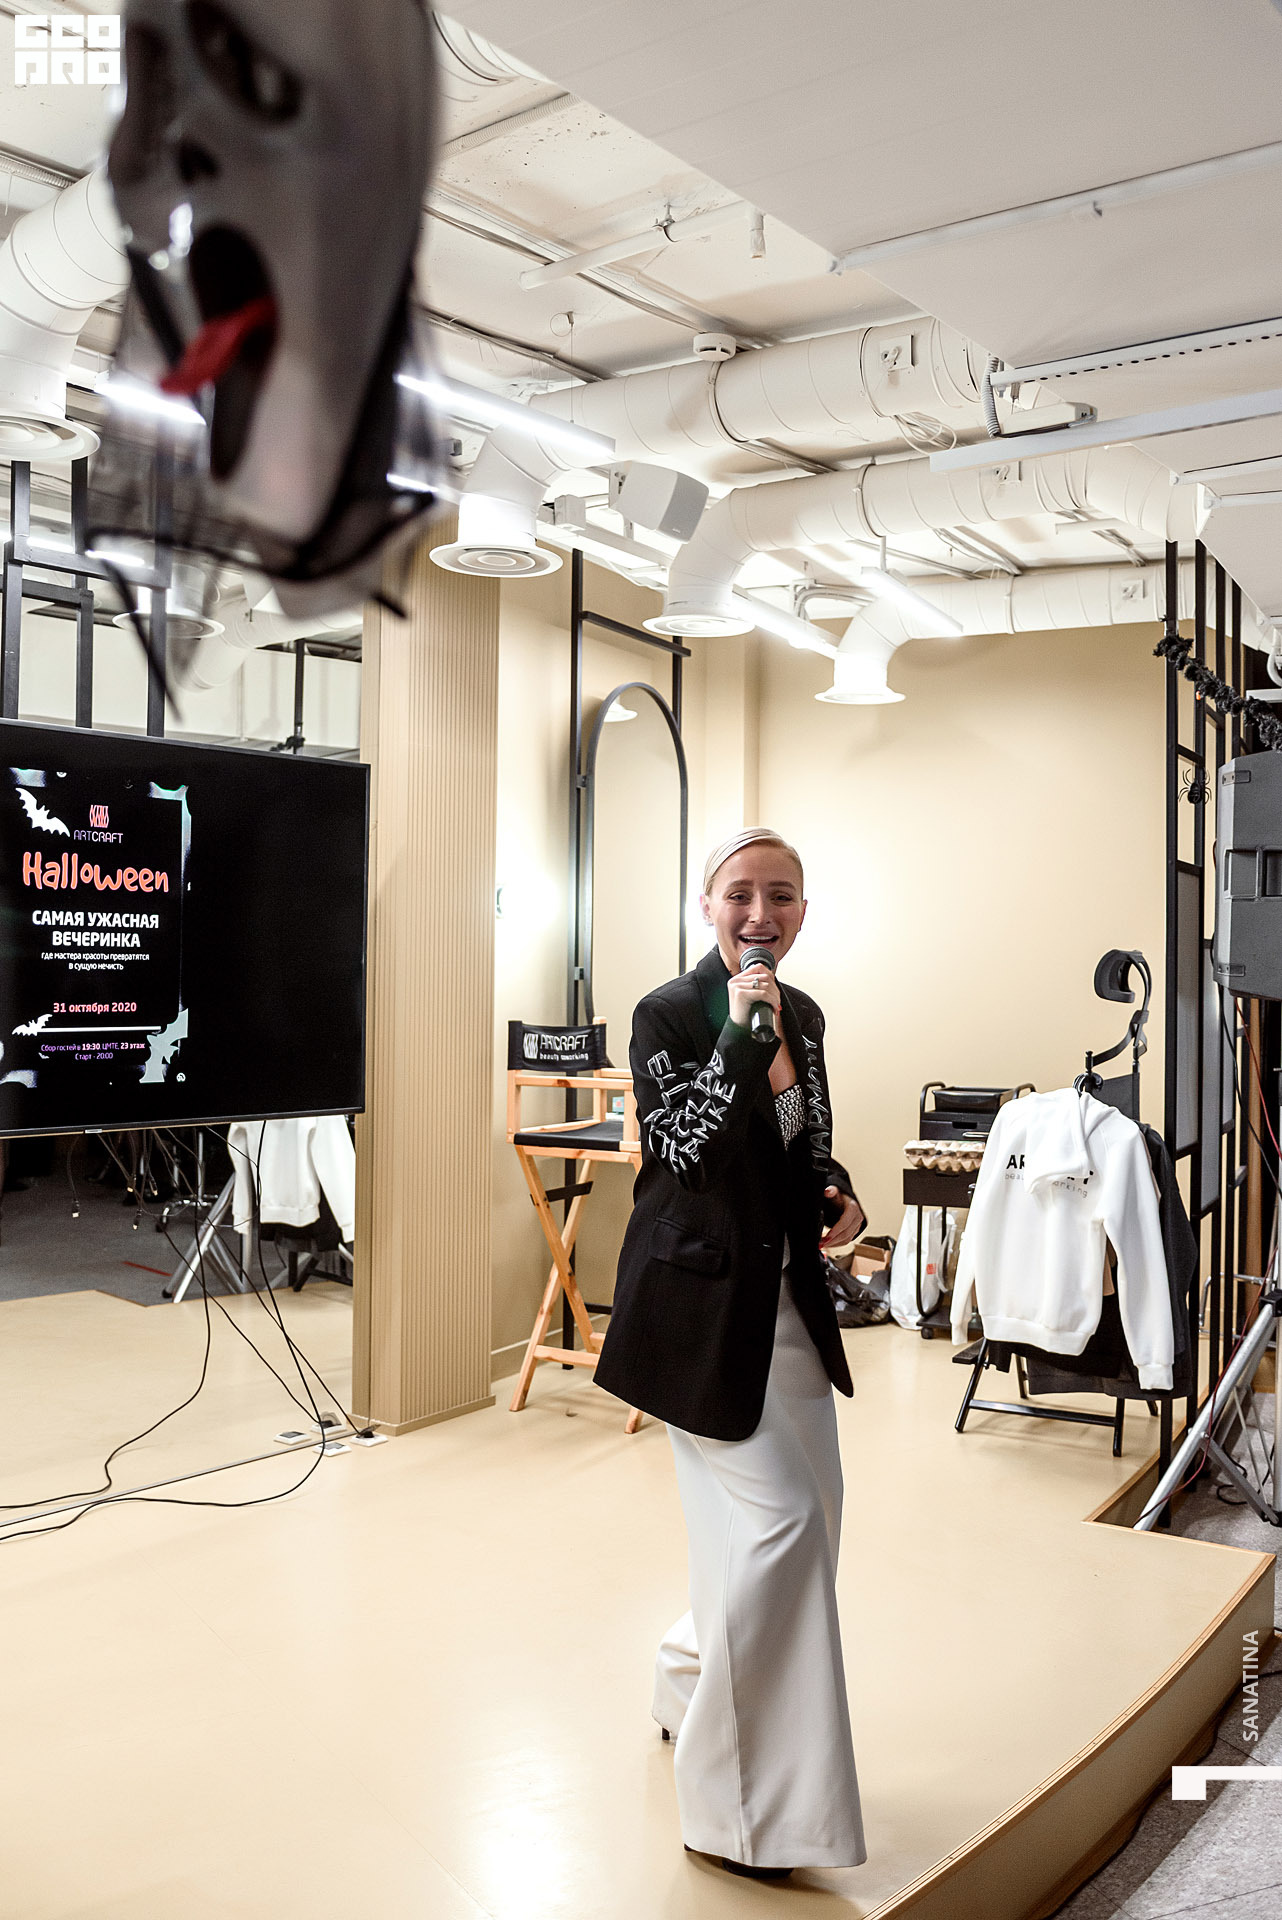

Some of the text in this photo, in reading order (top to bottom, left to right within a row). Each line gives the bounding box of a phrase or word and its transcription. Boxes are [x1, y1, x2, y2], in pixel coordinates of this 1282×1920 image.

[73, 830, 124, 843] ARTCRAFT
[23, 852, 169, 892] Halloween
[32, 910, 159, 928] САМАЯ УЖАСНАЯ
[52, 931, 140, 947] ВЕЧЕРИНКА
[41, 952, 149, 961] где мастера красоты превратятся
[74, 963, 97, 971] сущую
[53, 1002, 137, 1014] 31 октября 2020
[540, 1033, 588, 1051] ARTCRAFT
